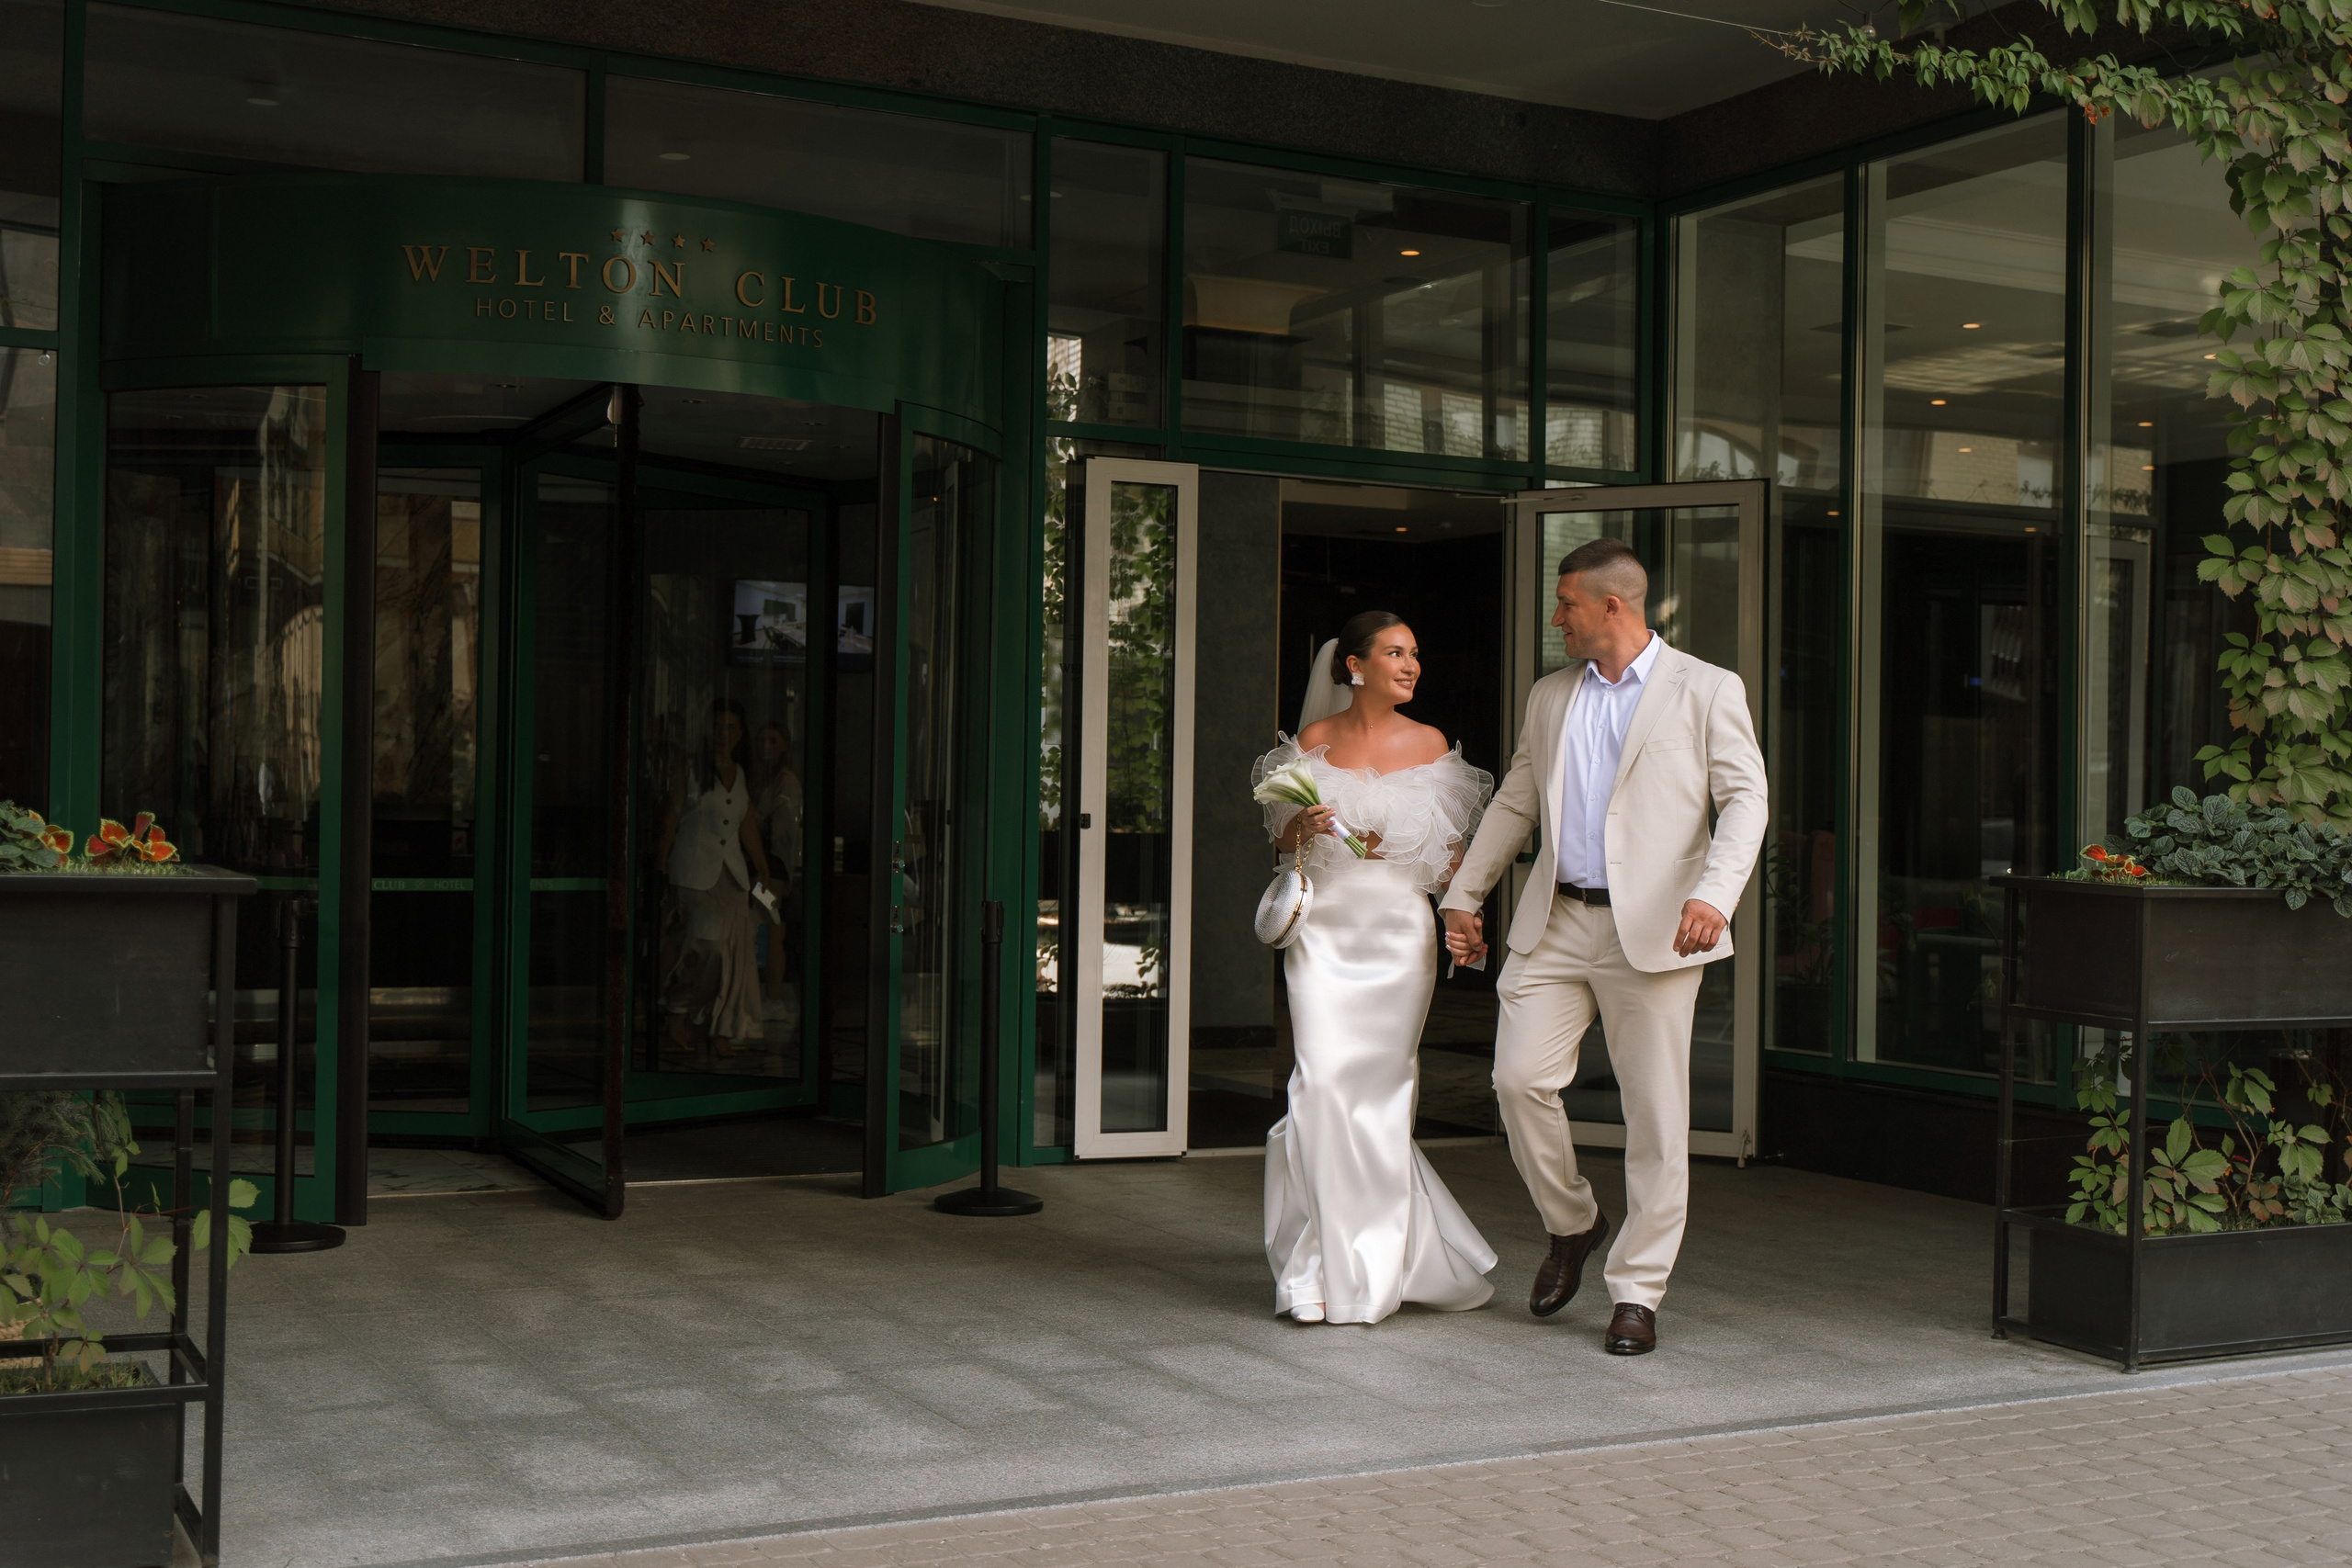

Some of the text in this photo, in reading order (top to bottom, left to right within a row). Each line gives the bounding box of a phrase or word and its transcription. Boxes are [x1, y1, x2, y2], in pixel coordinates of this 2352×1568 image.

[401, 244, 877, 326] WELTON CLUB
[476, 297, 824, 349] HOTEL & APARTMENTS
[373, 880, 466, 890] CLUB HOTEL
